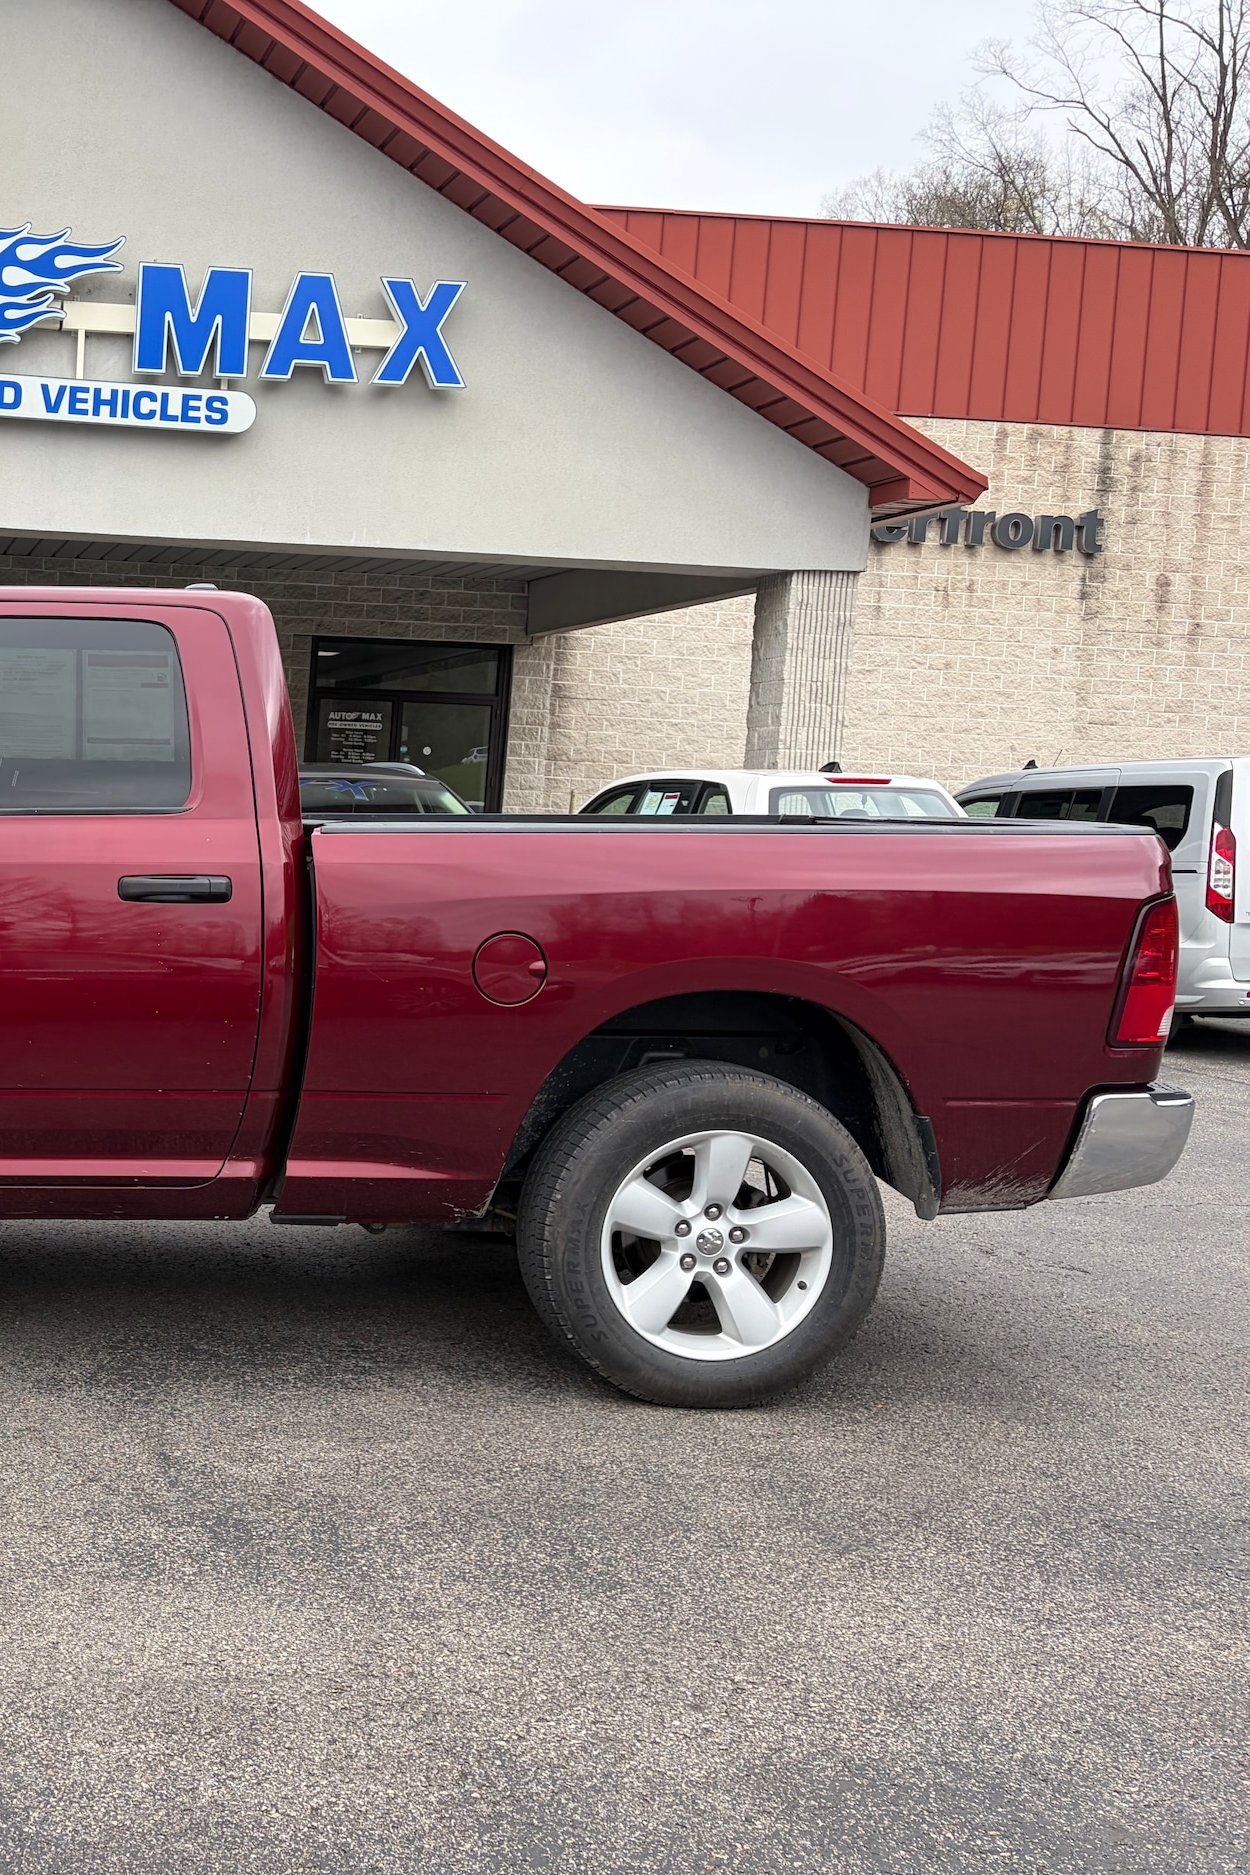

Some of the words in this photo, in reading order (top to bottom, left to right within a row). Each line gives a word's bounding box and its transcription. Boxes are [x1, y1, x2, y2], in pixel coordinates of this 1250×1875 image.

[130, 260, 469, 391] MAX
[40, 383, 230, 426] VEHICLES
[329, 711, 354, 720] AUTO
[362, 712, 383, 720] MAX
[566, 1201, 609, 1343] SUPERMAX
